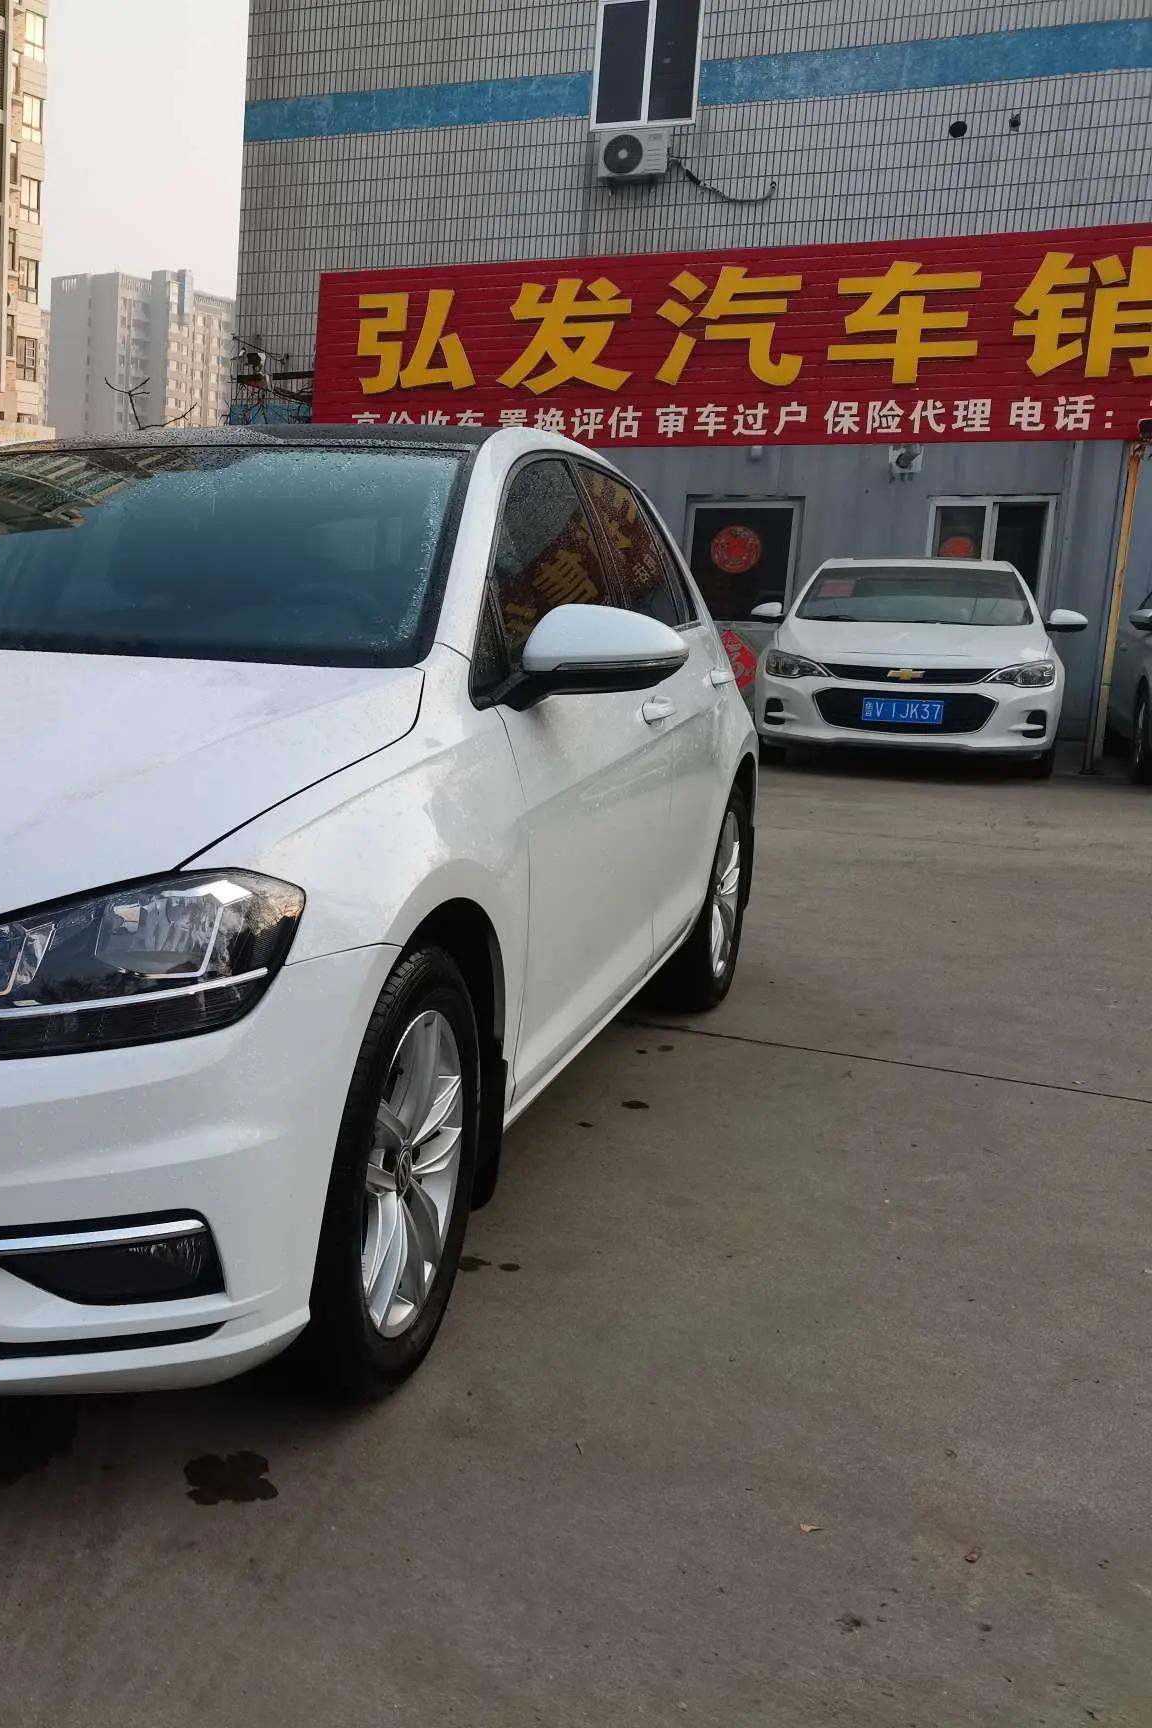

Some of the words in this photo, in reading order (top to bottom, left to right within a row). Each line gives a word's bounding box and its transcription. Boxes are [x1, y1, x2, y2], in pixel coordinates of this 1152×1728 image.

[358, 246, 1152, 394] 弘发汽车销
[656, 400, 808, 439] 审车过户
[824, 399, 993, 435] 保险代理
